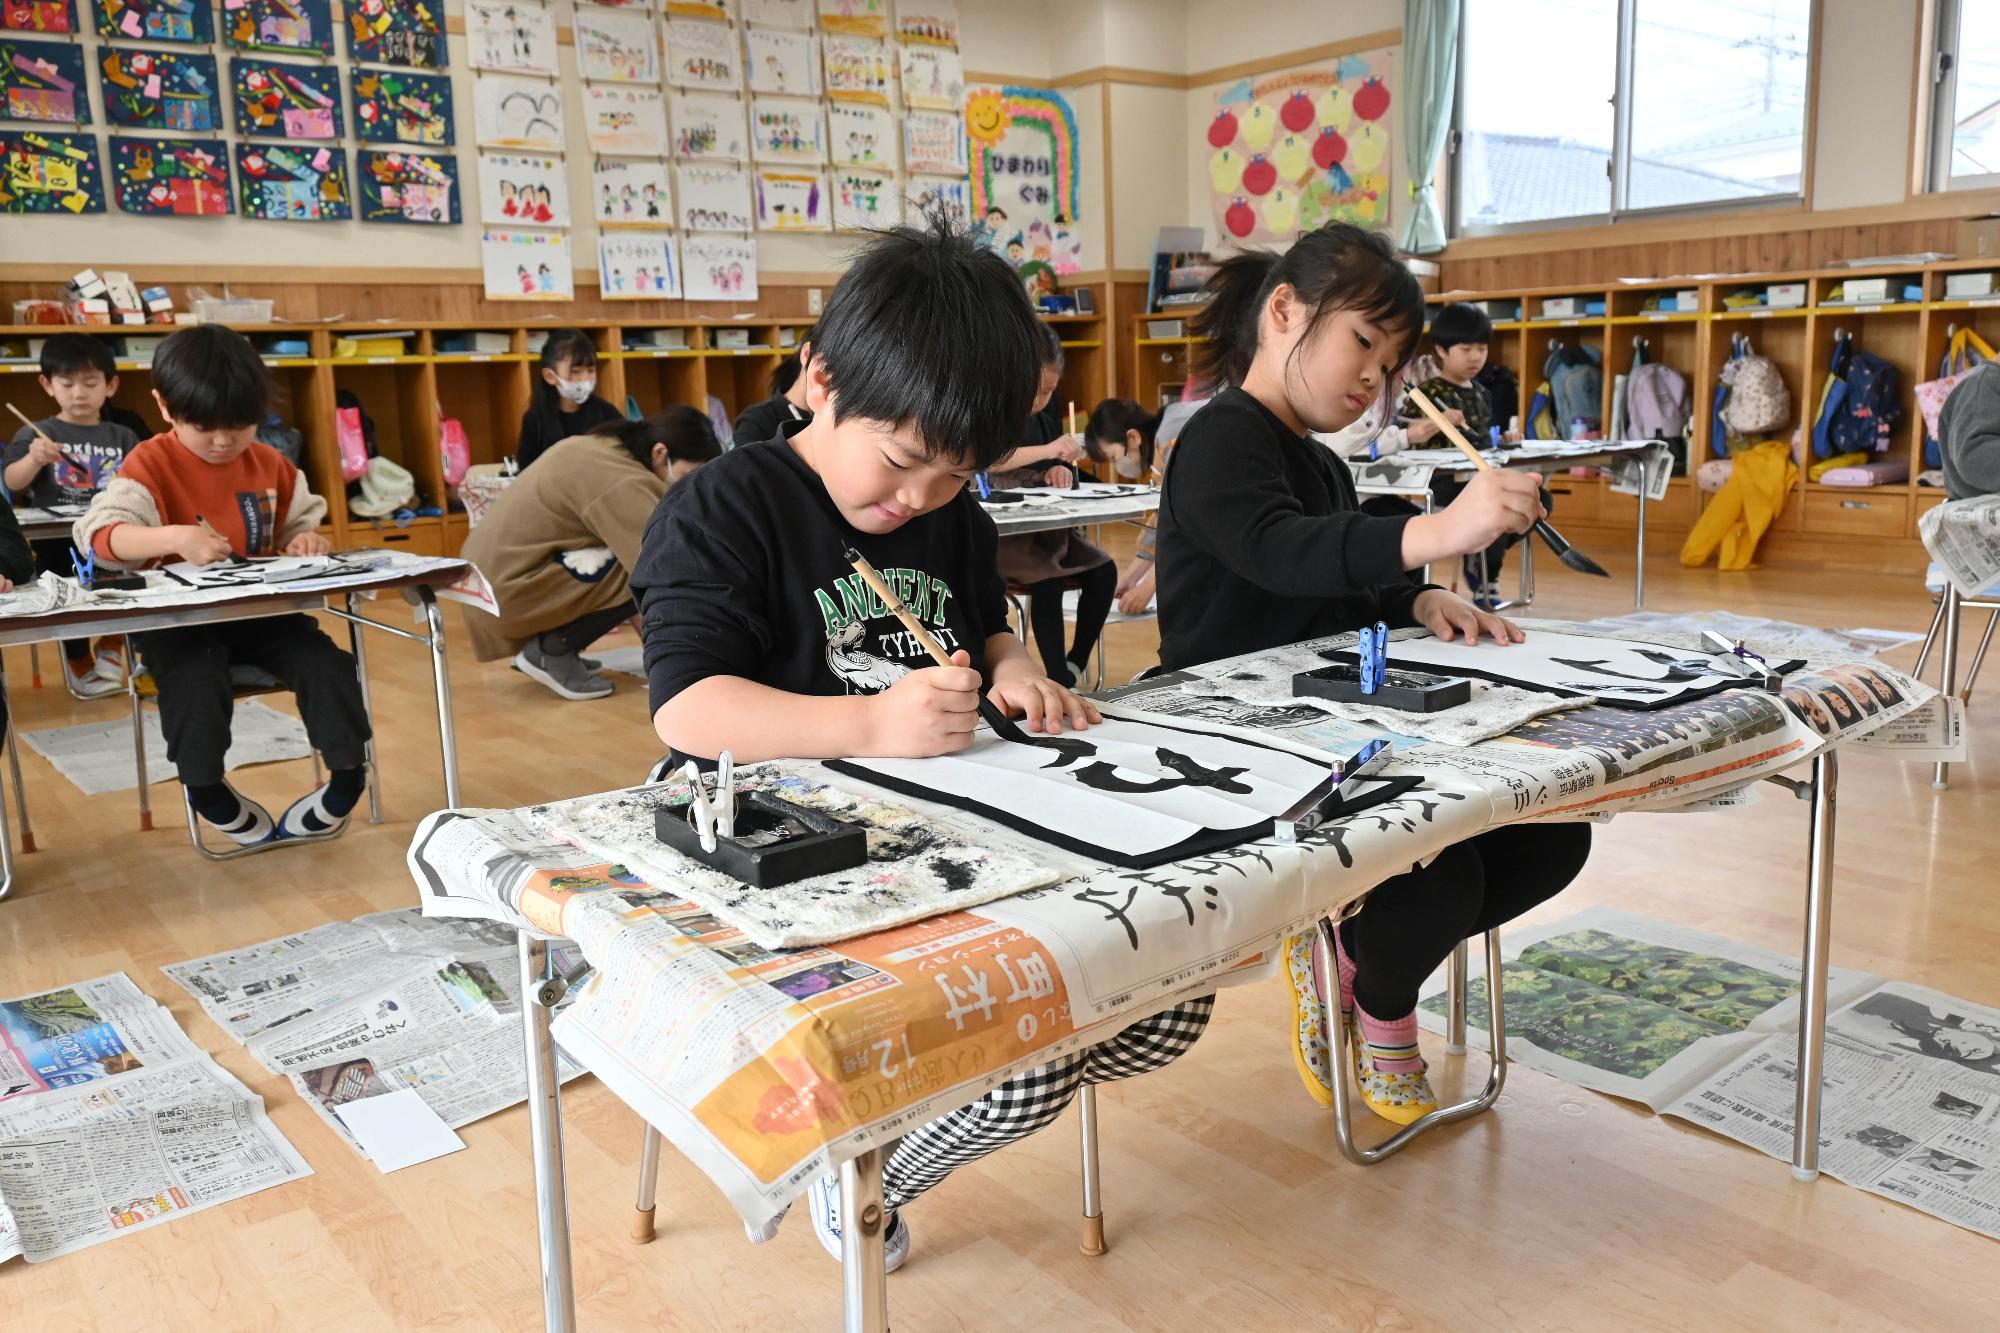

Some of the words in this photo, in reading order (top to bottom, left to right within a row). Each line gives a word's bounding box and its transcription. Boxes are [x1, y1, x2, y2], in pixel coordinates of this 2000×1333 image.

[991, 155, 1050, 176] ひまわり
[1019, 183, 1050, 205] ぐみ
[61, 440, 123, 458] OKÉMO
[813, 567, 953, 640] ANCIENT
[878, 627, 961, 658] TYRNT
[1549, 759, 1591, 782] あす号砲
[1649, 775, 1676, 789] Sports
[1558, 773, 1595, 799] 箱根駅伝
[933, 950, 1055, 1032] 町村
[280, 1045, 334, 1067] 用地不足
[336, 1018, 407, 1051] 危険やむなく
